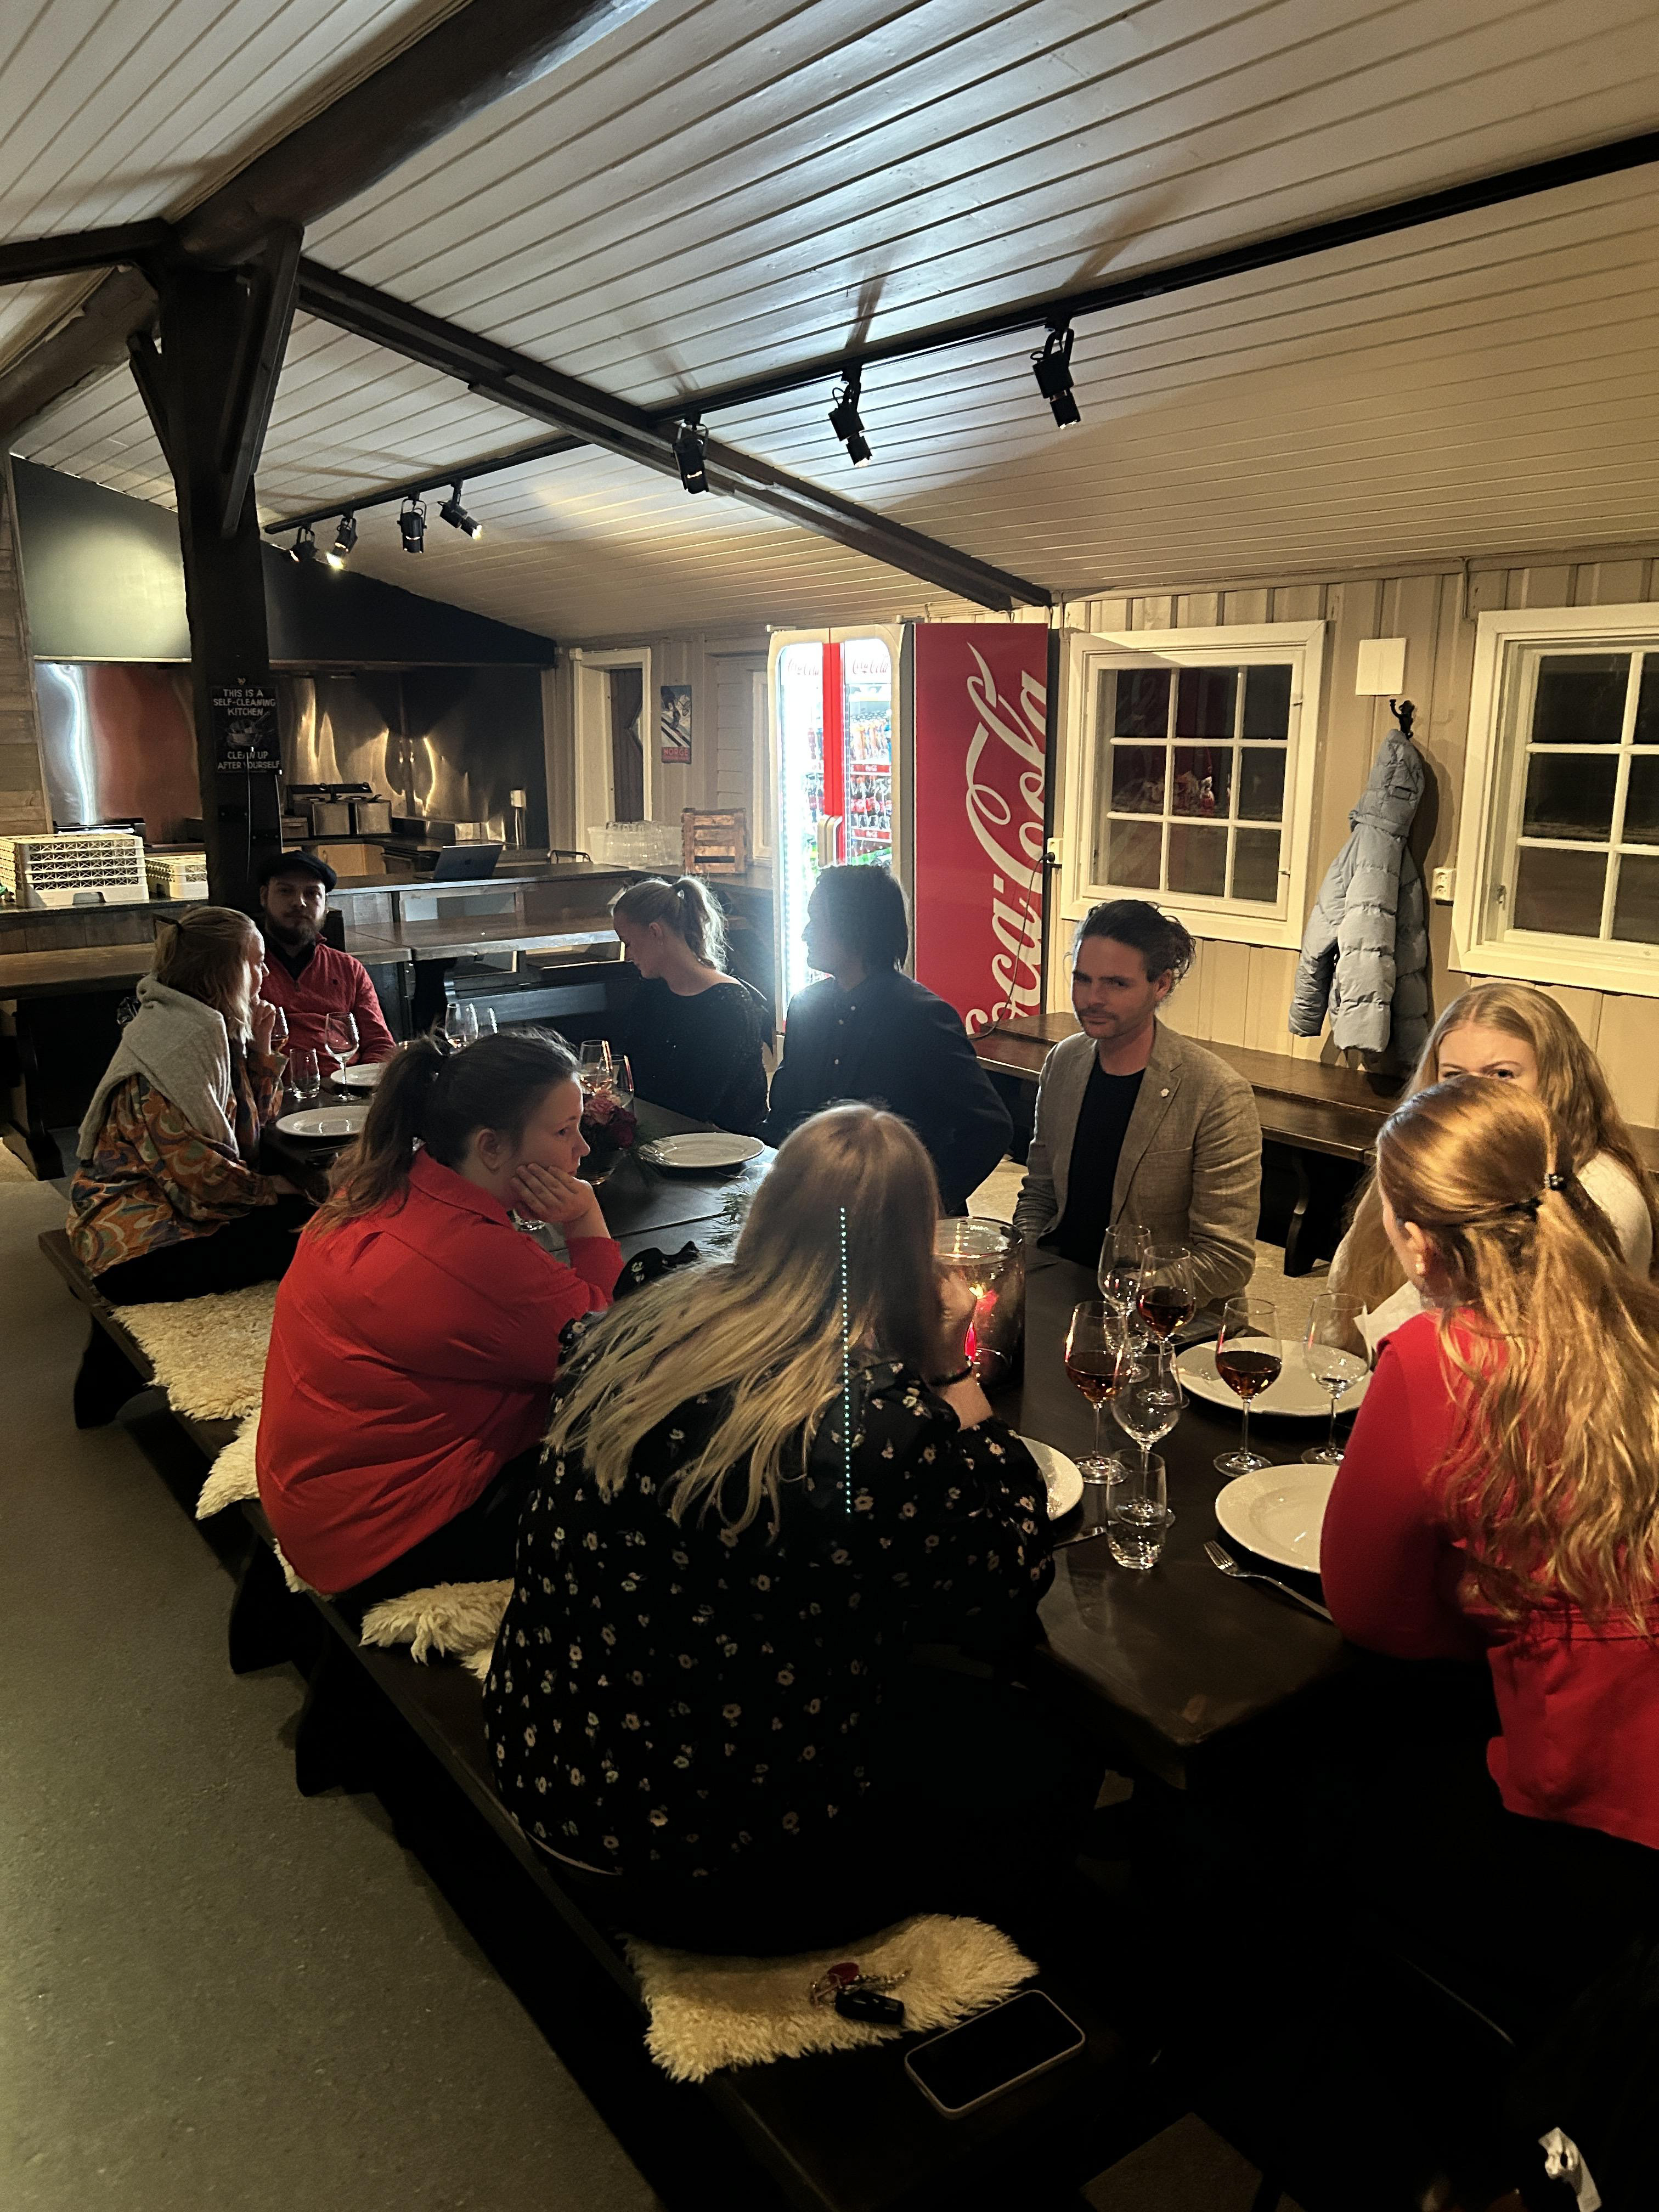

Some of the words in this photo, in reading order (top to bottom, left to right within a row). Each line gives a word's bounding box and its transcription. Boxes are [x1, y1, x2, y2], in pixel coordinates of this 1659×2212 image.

[223, 689, 242, 697] THIS
[245, 689, 253, 697] IS
[213, 698, 276, 707] SELF-CLEANING
[228, 708, 263, 716] KITCHEN
[257, 751, 269, 759] UP
[218, 761, 241, 770] AFTER
